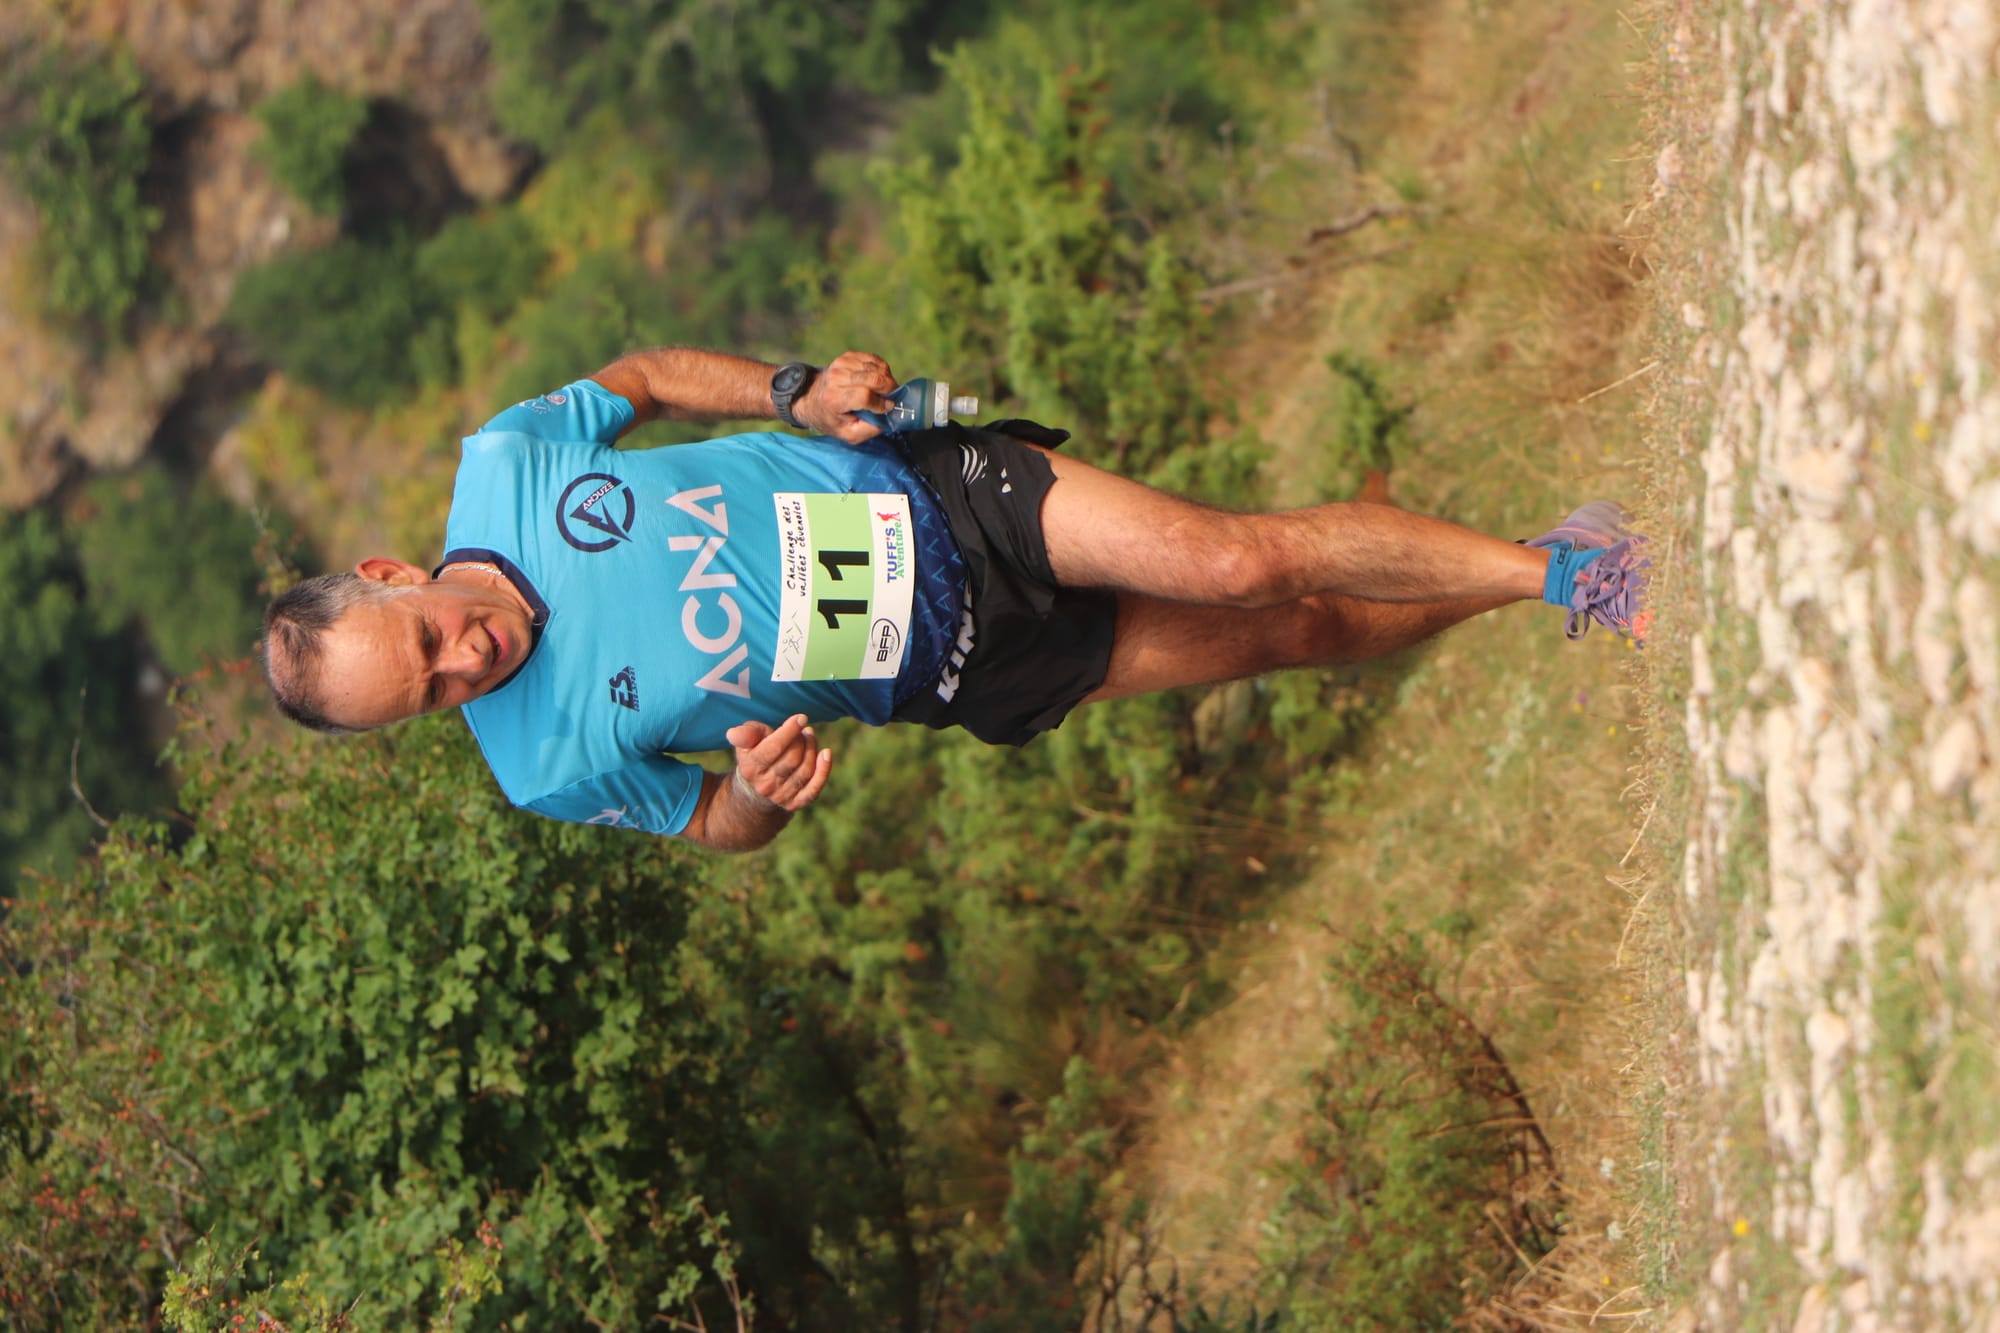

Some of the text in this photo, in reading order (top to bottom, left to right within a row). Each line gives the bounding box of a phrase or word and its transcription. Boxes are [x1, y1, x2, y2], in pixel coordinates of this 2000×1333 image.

[583, 481, 615, 511] ANDUZE
[782, 505, 798, 590] Challenge des
[793, 500, 807, 597] vallées cévenoles
[885, 527, 897, 583] TUFF'S
[894, 521, 904, 578] Aventure
[664, 484, 751, 699] ACNA
[817, 550, 870, 629] 11
[876, 625, 891, 662] BFP
